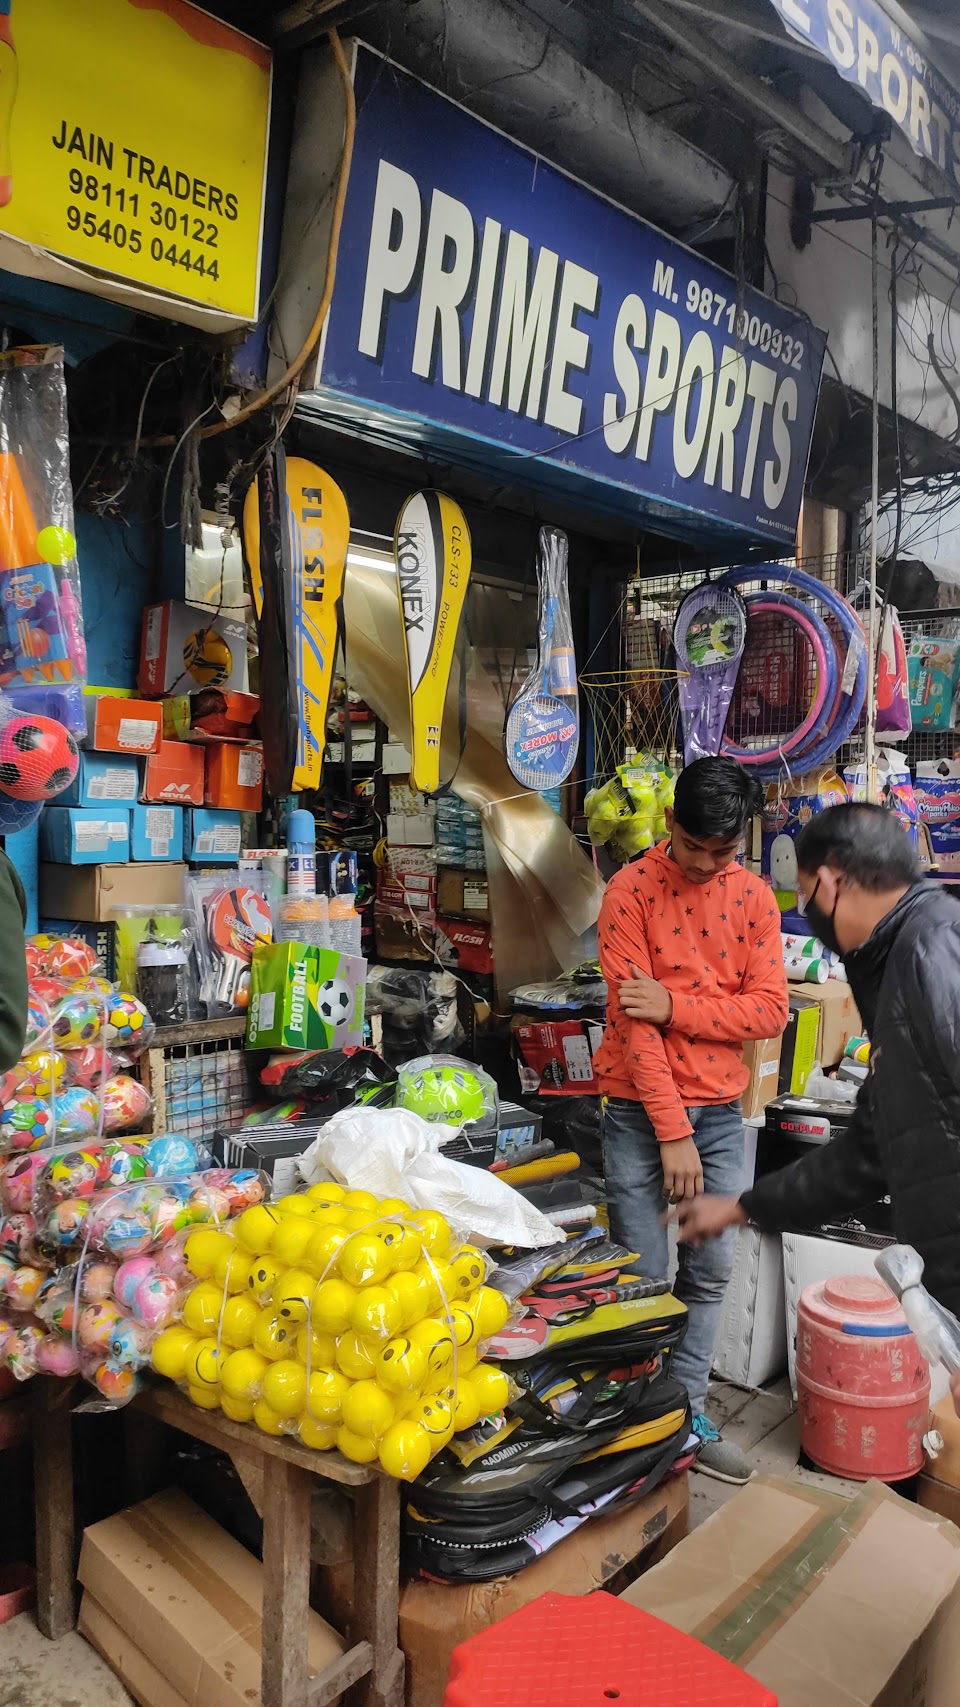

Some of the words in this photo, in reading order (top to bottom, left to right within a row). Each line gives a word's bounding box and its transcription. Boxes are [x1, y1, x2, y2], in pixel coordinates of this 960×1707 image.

[52, 120, 114, 170] JAIN
[123, 149, 239, 221] TRADERS
[68, 168, 139, 217] 98111
[150, 201, 219, 248] 30122
[66, 205, 142, 254] 95405
[150, 238, 220, 282] 04444
[358, 158, 599, 436] PRIME
[652, 259, 678, 304] M.
[602, 293, 798, 510] SPORTS
[301, 487, 325, 602] FLASH
[449, 525, 463, 588] CLS-133
[397, 532, 425, 633] KONEX
[431, 601, 450, 678] POWER-PRO
[911, 670, 928, 707] Pampers
[118, 741, 152, 750] COSCO
[304, 691, 313, 772] www.flashsports.in
[520, 730, 558, 753] MOREX
[159, 791, 192, 800] NIVIA
[453, 932, 485, 946] FLASH
[248, 992, 260, 1043] COSCO
[289, 960, 308, 1032] FOOTBALL
[426, 1109, 463, 1122] COSCO
[890, 1348, 904, 1383] SAN
[860, 1425, 877, 1459] SAN
